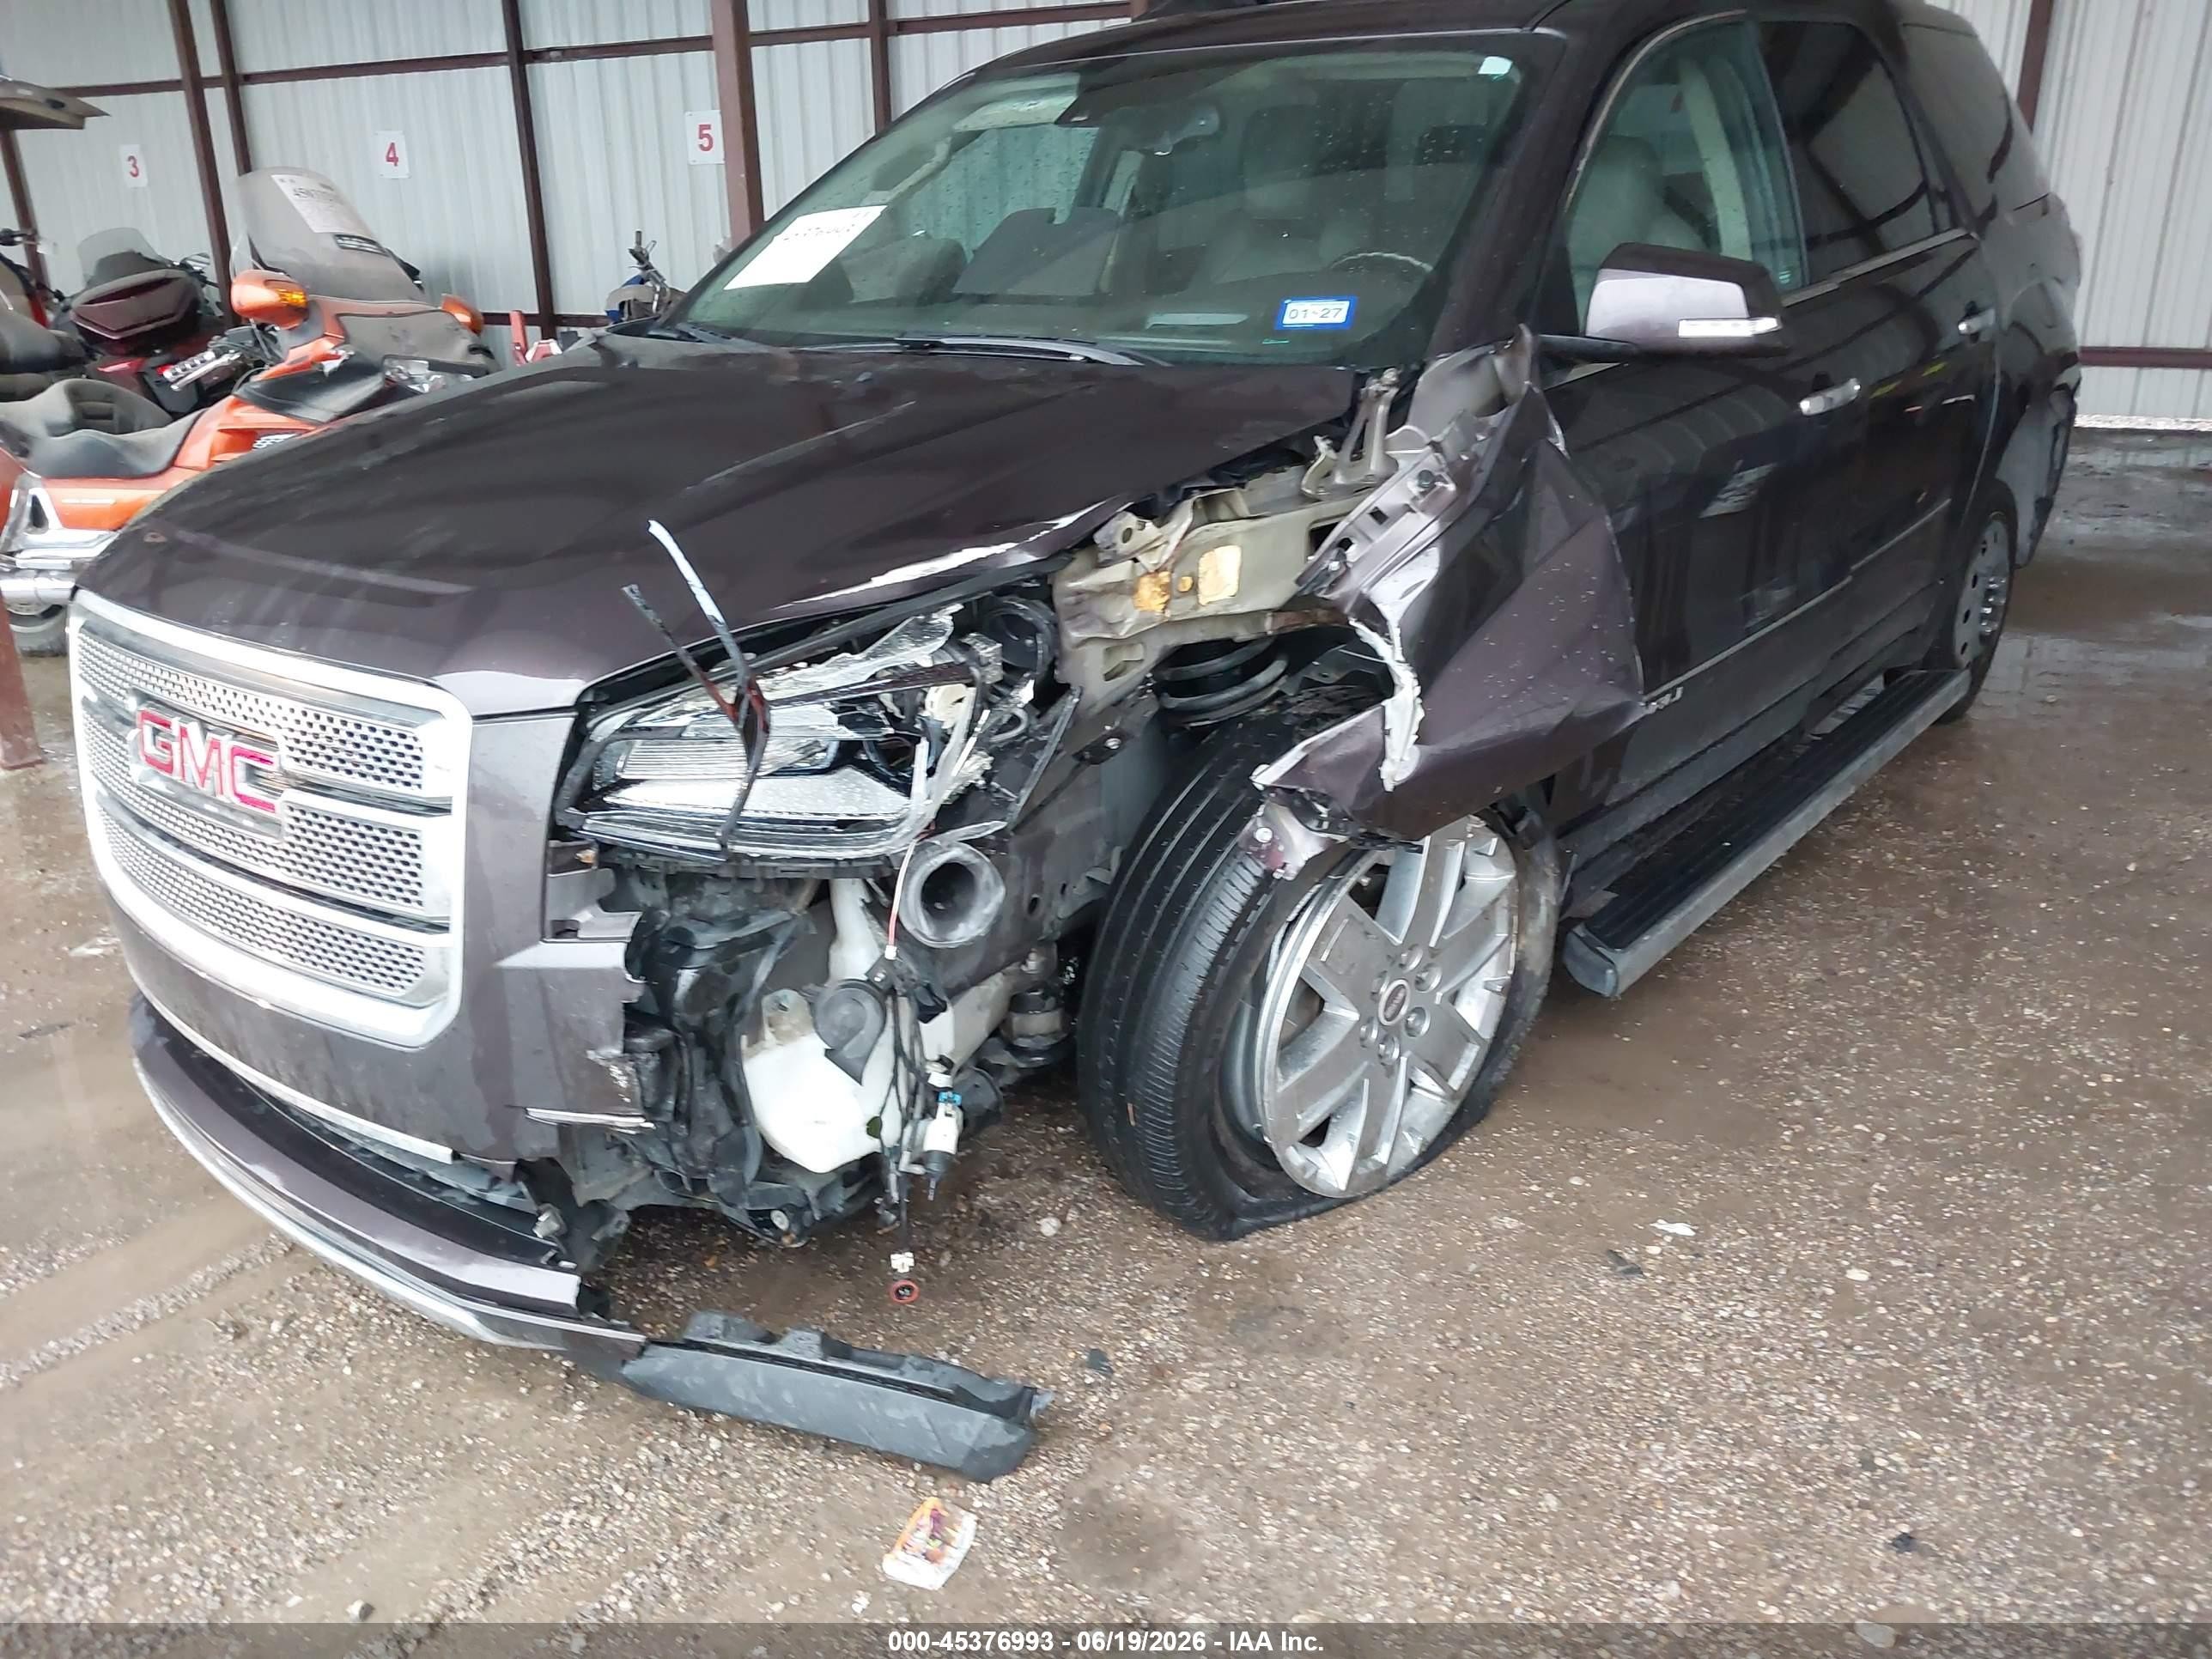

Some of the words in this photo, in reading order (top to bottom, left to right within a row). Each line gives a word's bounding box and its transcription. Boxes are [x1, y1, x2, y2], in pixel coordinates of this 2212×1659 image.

[698, 124, 714, 152] 5
[127, 155, 139, 178] 3
[386, 142, 399, 167] 4
[137, 707, 280, 818] GMC
